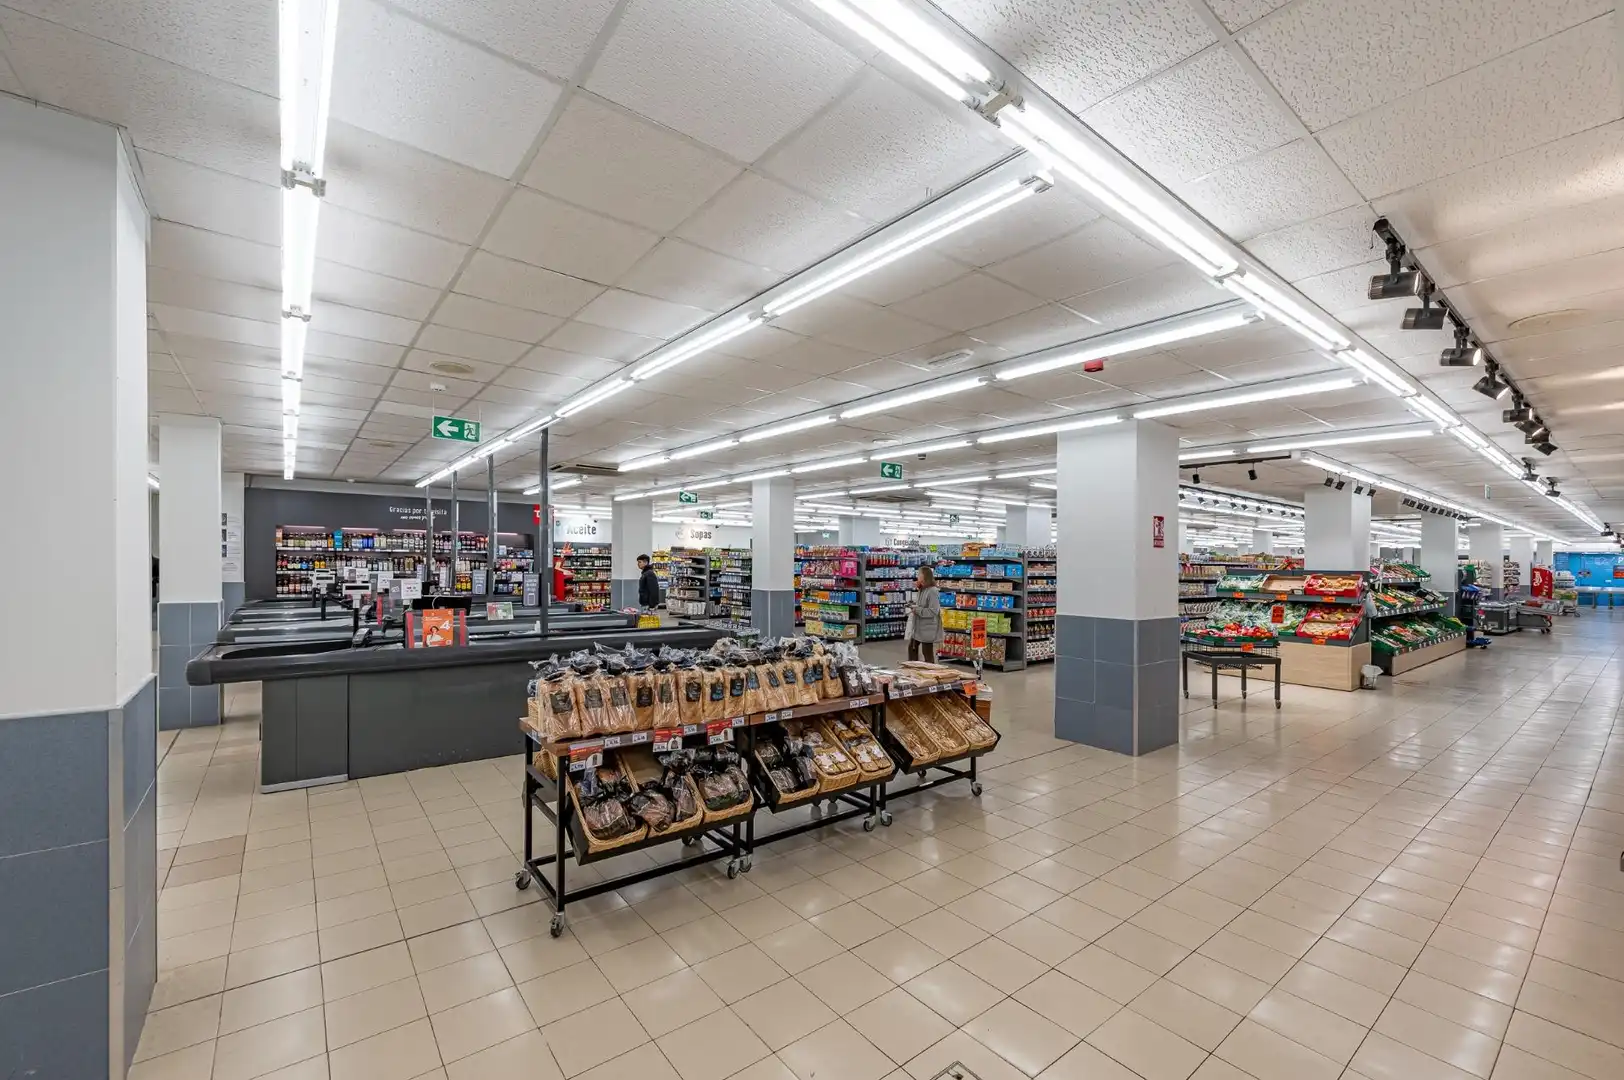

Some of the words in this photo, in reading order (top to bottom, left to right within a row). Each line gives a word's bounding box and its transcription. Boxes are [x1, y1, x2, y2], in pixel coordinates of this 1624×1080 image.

[389, 506, 411, 514] Gracias
[566, 523, 597, 535] Aceite
[690, 528, 712, 541] Sopas
